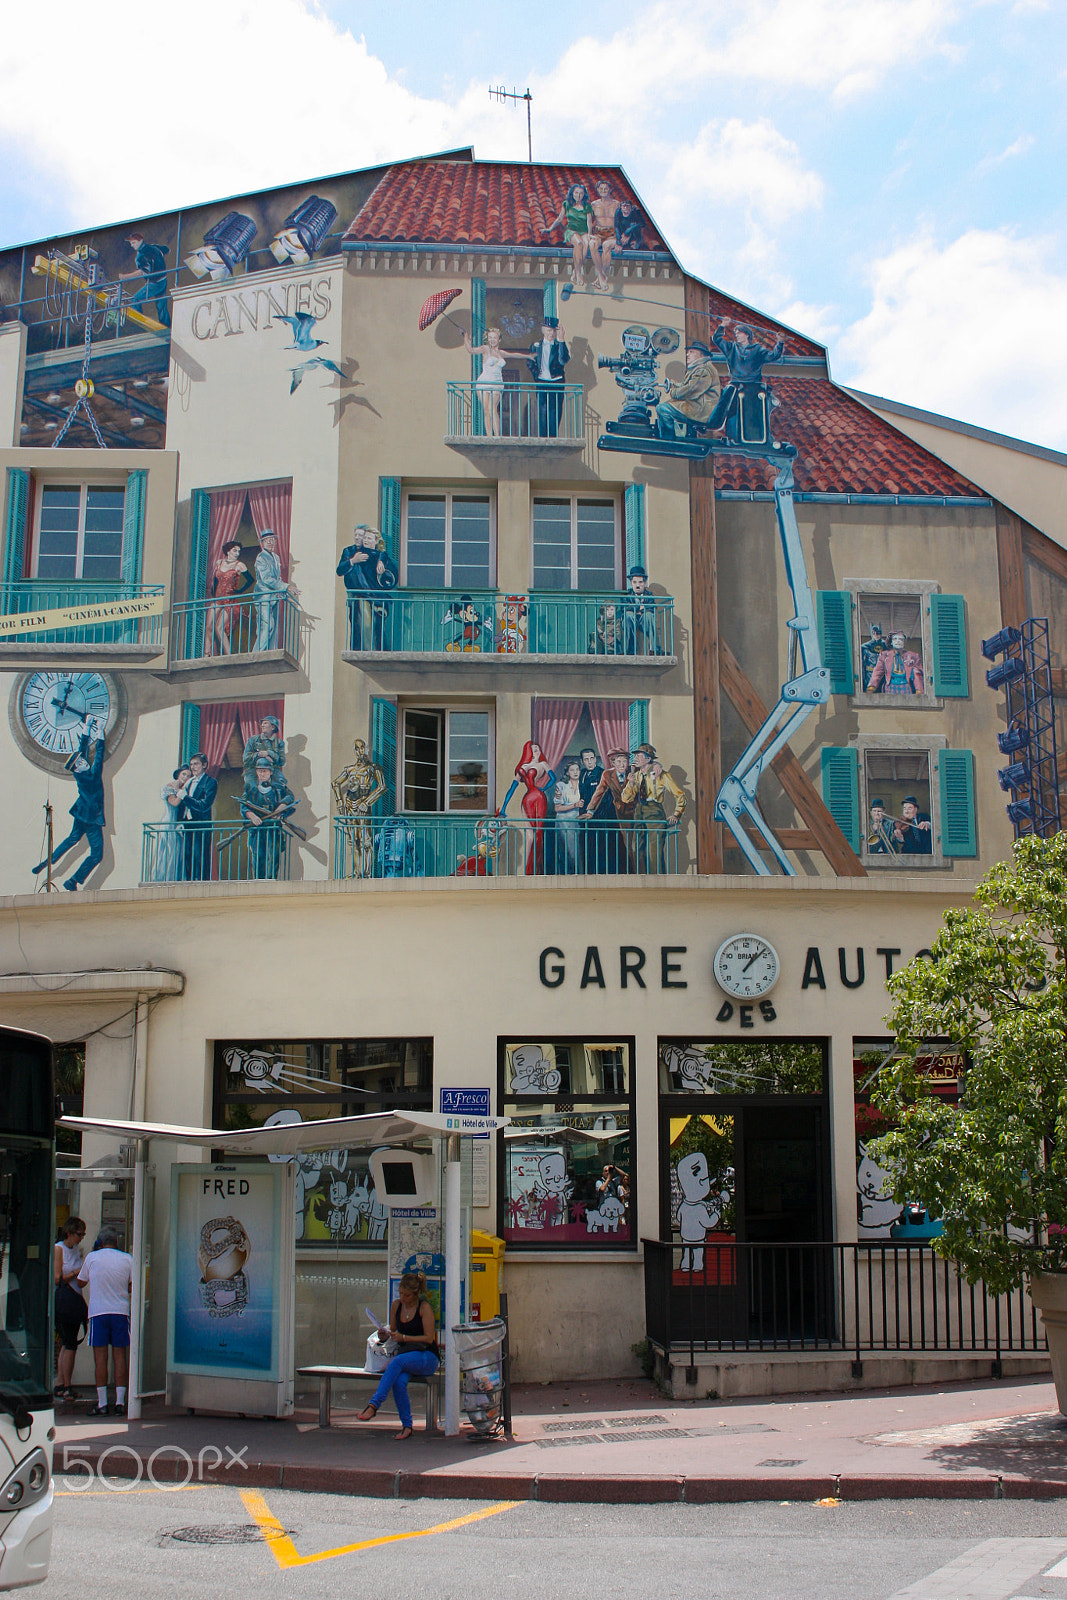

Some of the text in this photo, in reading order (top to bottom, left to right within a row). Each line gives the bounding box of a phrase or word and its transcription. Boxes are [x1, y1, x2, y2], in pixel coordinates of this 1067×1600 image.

[191, 276, 332, 341] CANNES
[0, 620, 16, 630] OR
[20, 616, 46, 627] FILM
[539, 946, 688, 989] GARE
[716, 999, 777, 1028] DES
[462, 1118, 477, 1127] Hôtel
[478, 1119, 485, 1127] de
[486, 1119, 498, 1128] Ville
[203, 1179, 250, 1199] FRED
[392, 1209, 436, 1217] Hôtel de Ville
